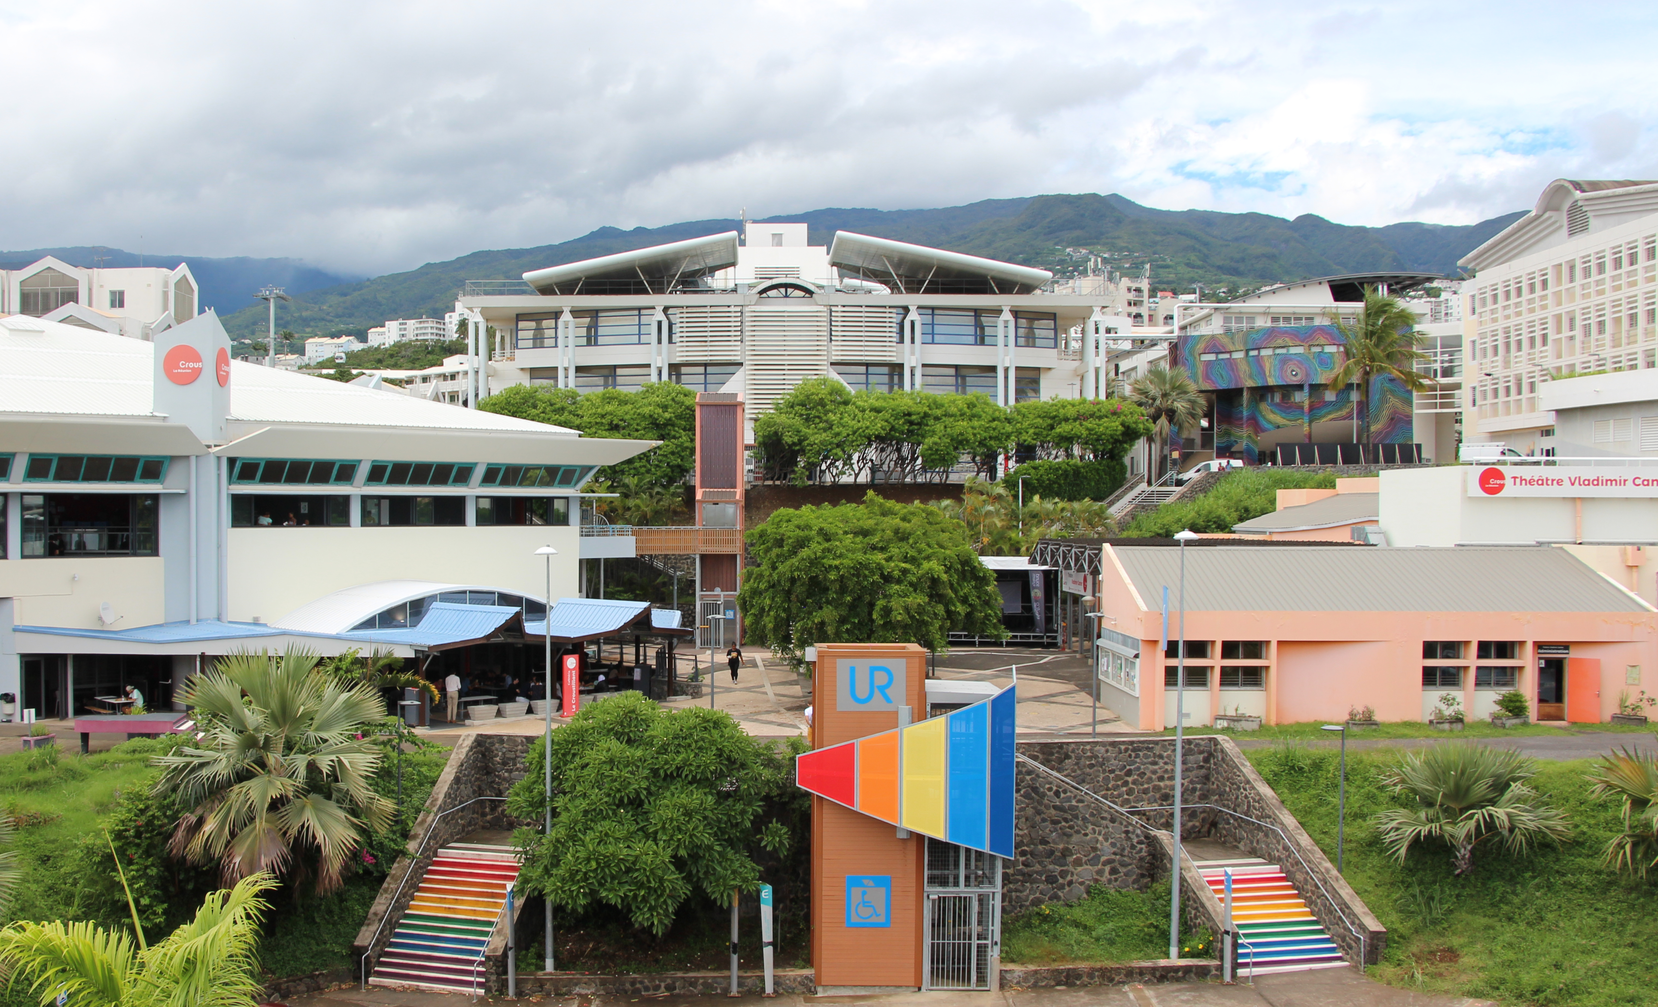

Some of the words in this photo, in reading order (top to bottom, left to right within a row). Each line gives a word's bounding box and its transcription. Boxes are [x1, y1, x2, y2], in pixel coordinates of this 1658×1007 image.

[1511, 475, 1564, 487] Théâtre
[1568, 475, 1629, 487] Vladimir
[849, 665, 894, 705] UR
[571, 704, 576, 712] Le
